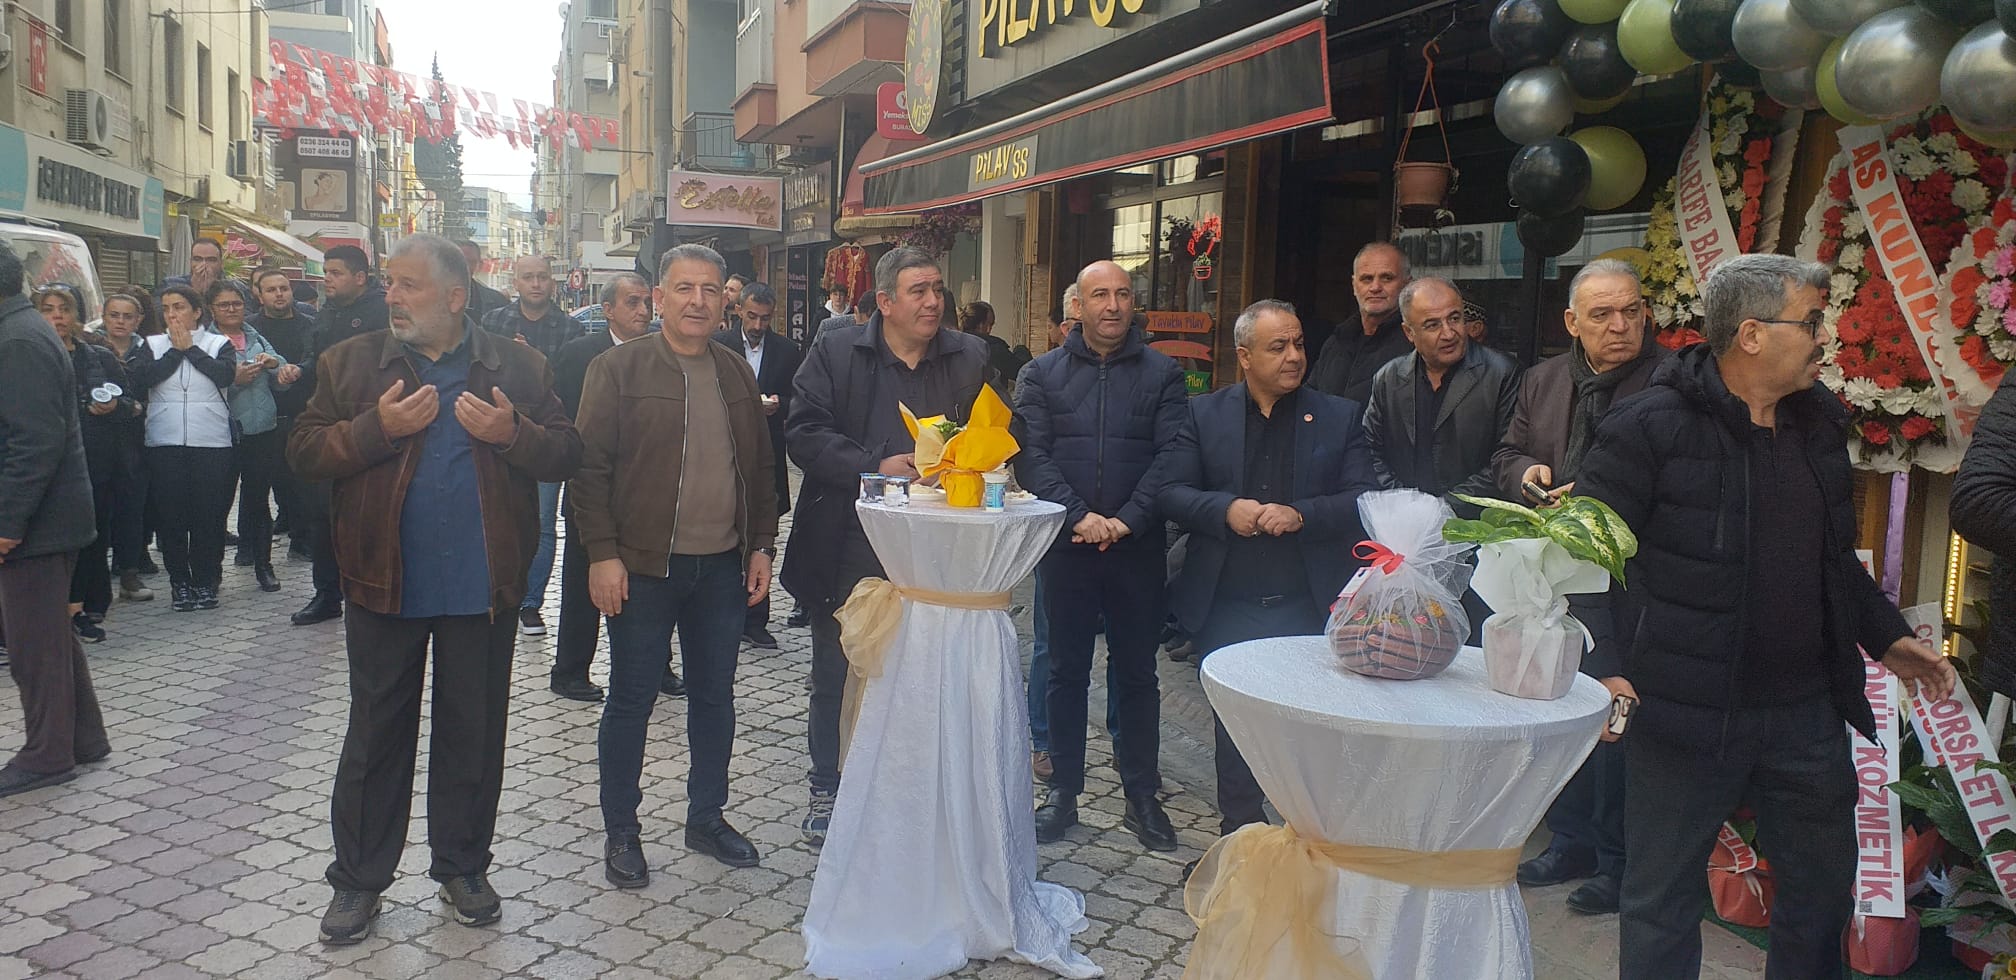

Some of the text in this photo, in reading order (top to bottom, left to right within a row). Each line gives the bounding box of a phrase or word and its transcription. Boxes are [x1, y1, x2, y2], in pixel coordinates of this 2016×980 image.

[1851, 139, 1888, 191] AS
[1960, 773, 2005, 808] ET
[1855, 746, 1900, 902] KOZMETİK
